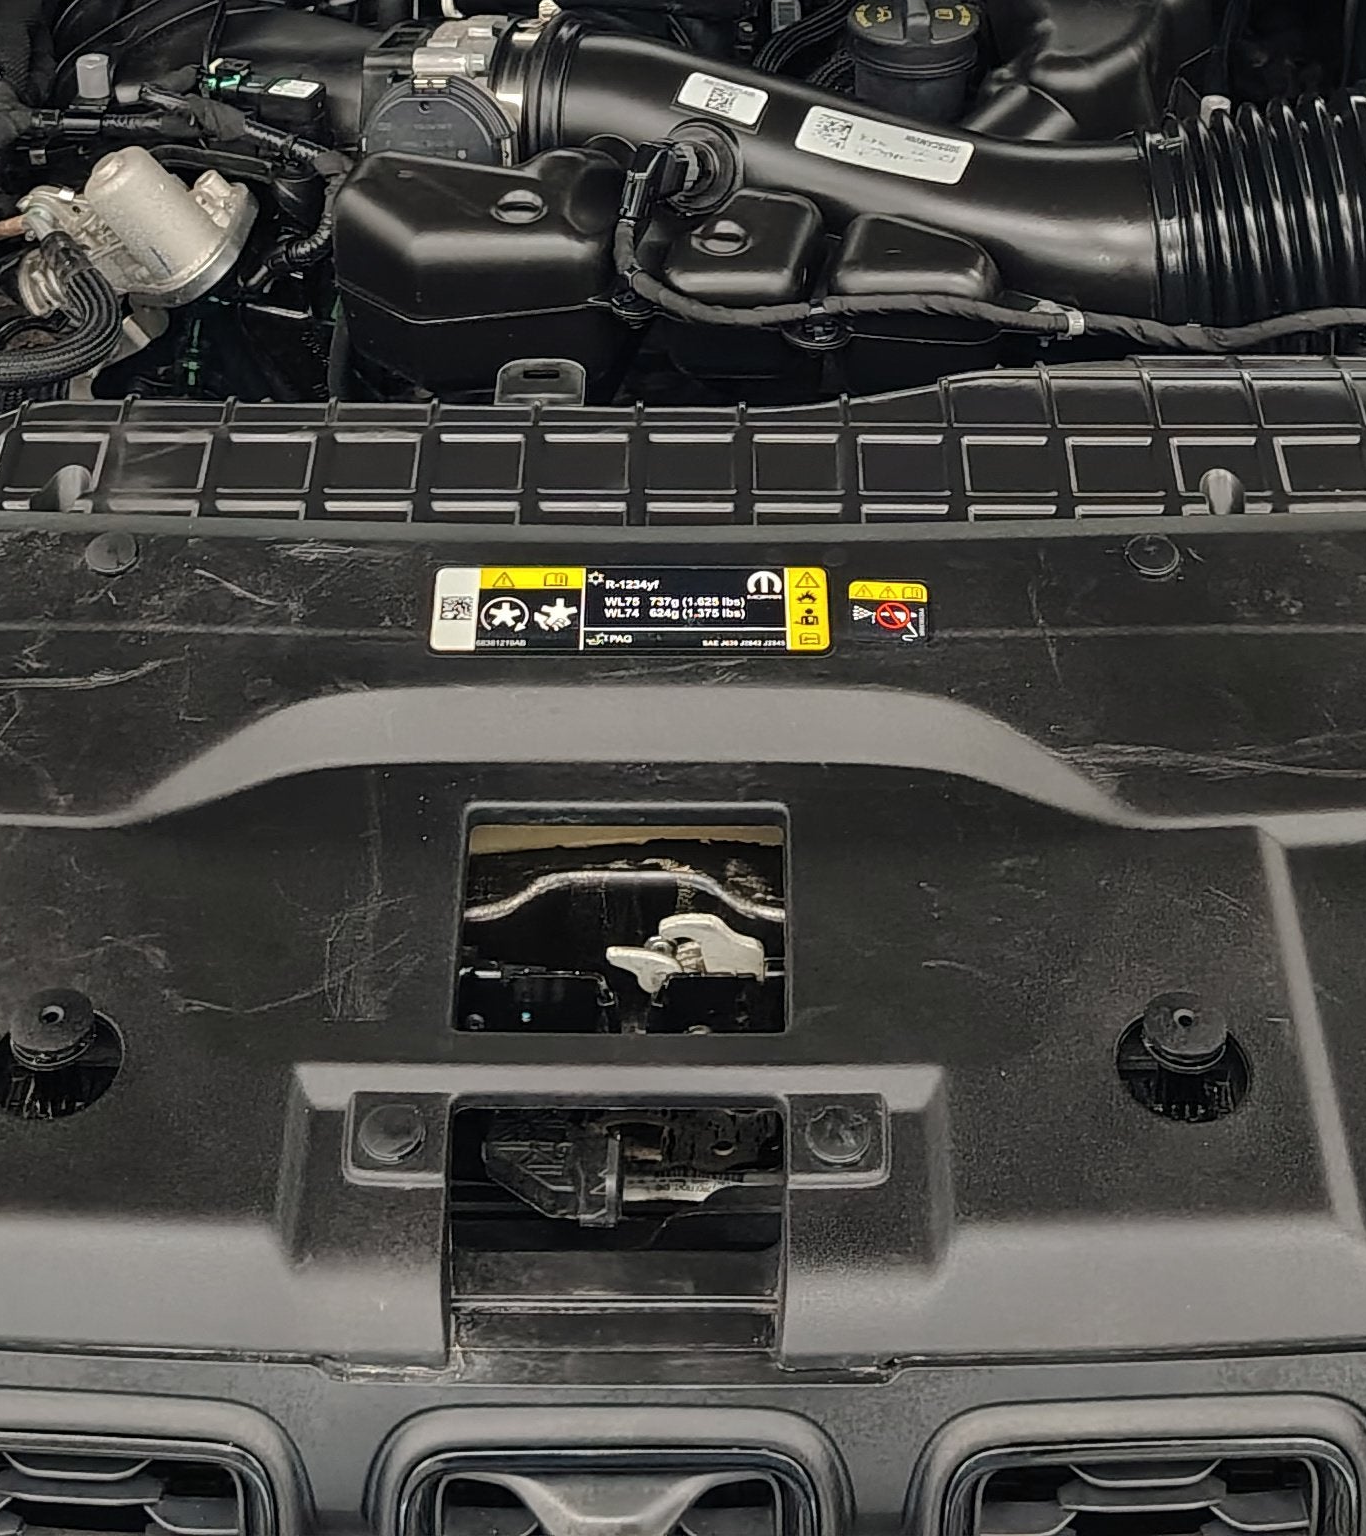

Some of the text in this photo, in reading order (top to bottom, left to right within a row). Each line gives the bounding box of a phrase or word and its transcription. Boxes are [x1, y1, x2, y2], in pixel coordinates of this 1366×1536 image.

[605, 579, 660, 592] R-1234yf
[604, 596, 746, 609] WL75 737g (1.625 lbs)
[604, 607, 746, 620] WL74 624g (1.375 lbs)
[609, 634, 633, 644] PAG
